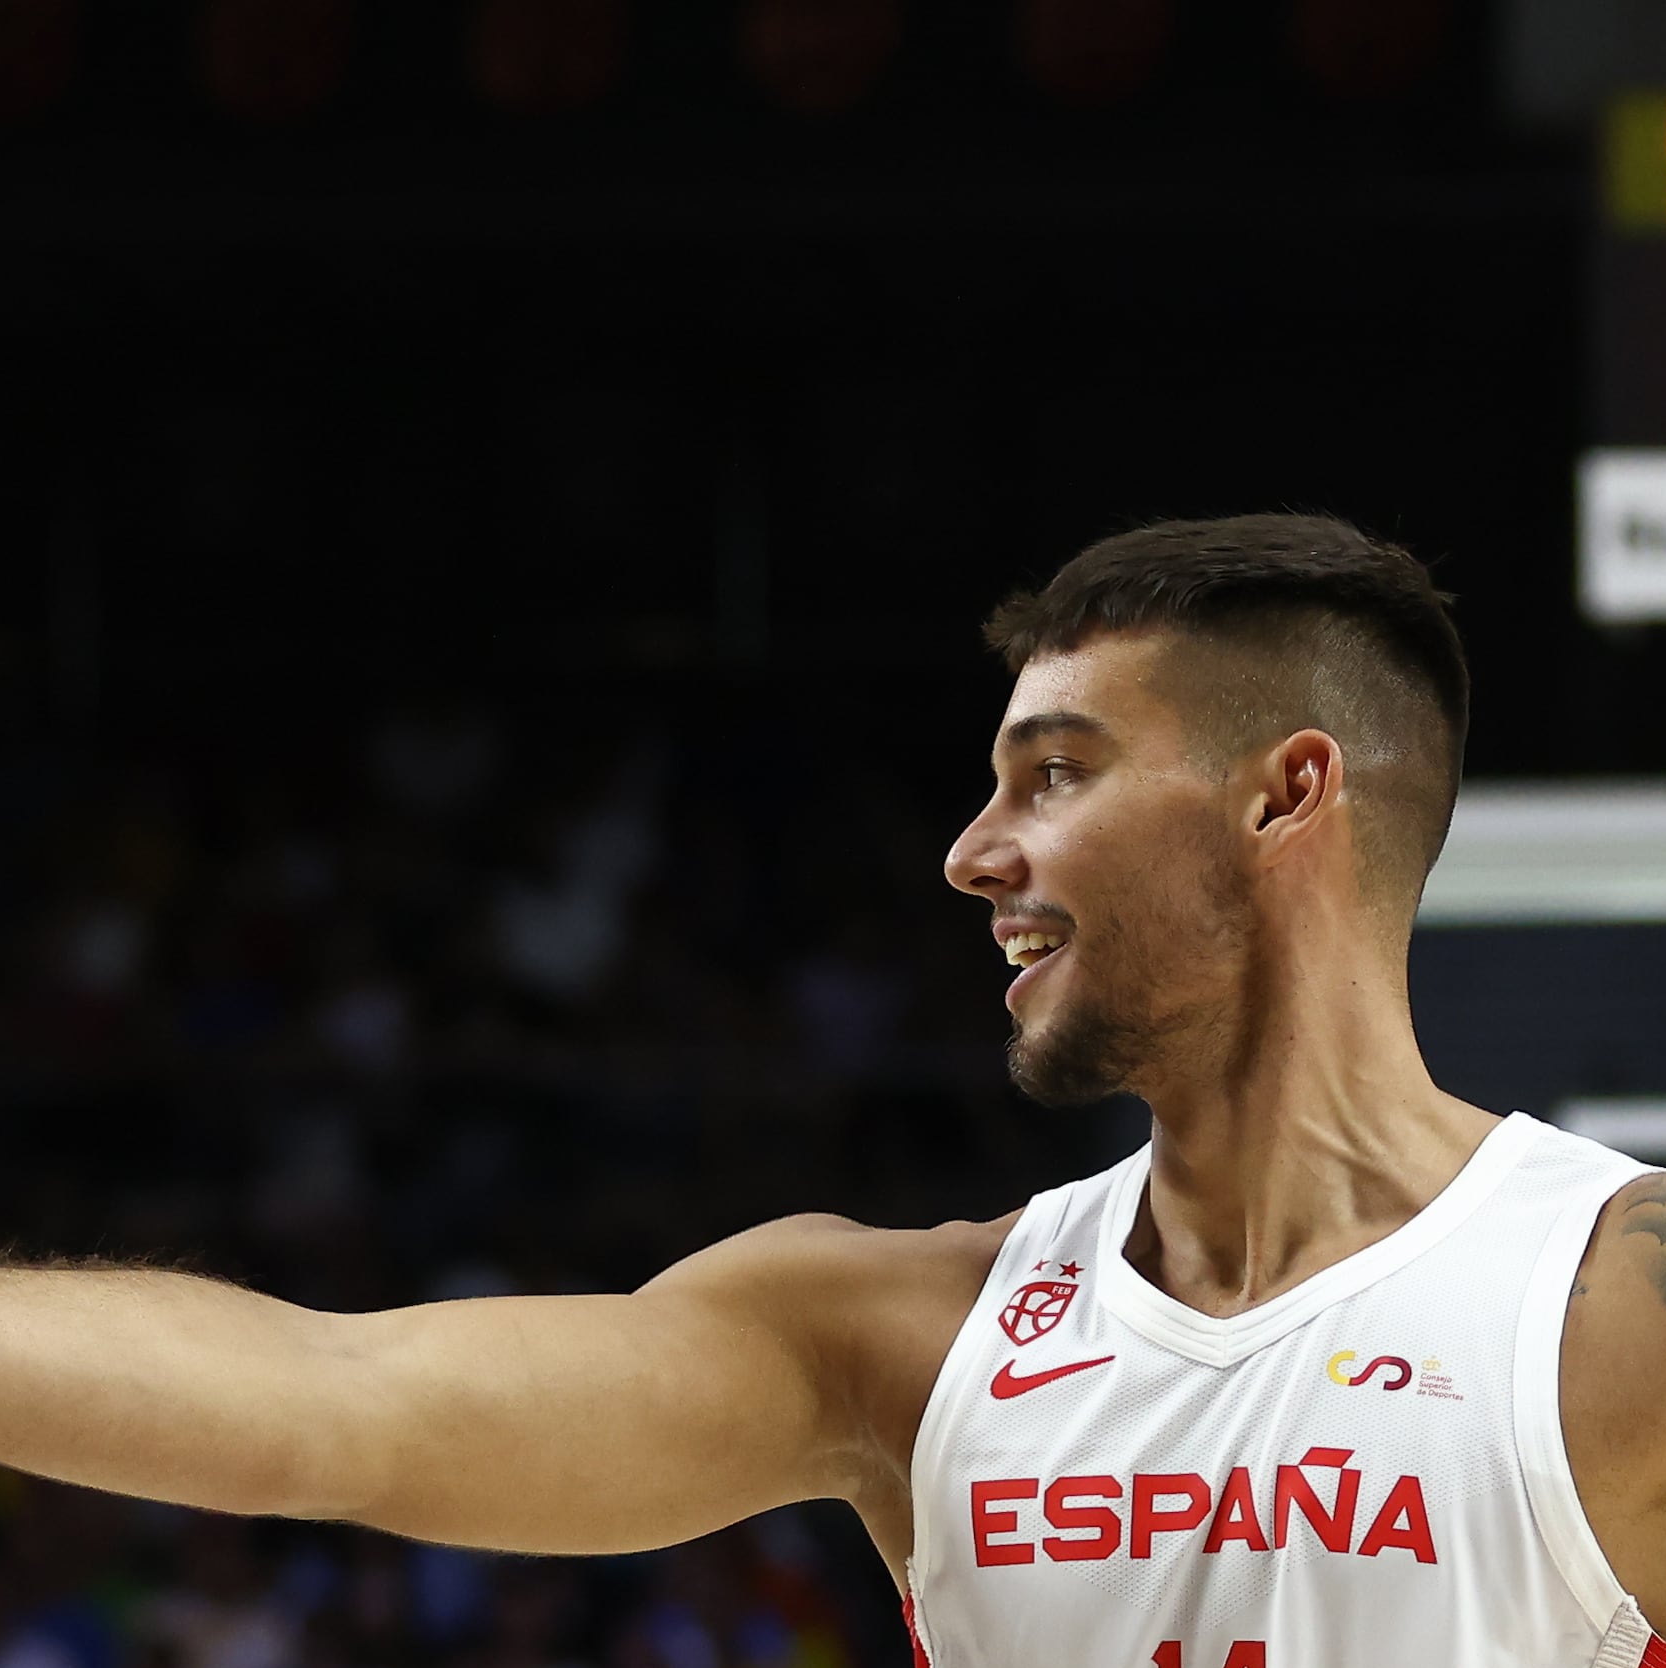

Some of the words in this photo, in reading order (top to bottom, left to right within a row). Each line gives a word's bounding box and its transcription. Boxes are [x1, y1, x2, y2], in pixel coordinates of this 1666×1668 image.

[1051, 1284, 1073, 1296] FEB
[1420, 1371, 1453, 1384] Consejo
[1418, 1380, 1452, 1391] Superior
[1428, 1389, 1465, 1401] Deportes
[970, 1446, 1439, 1568] ESPAÑA
